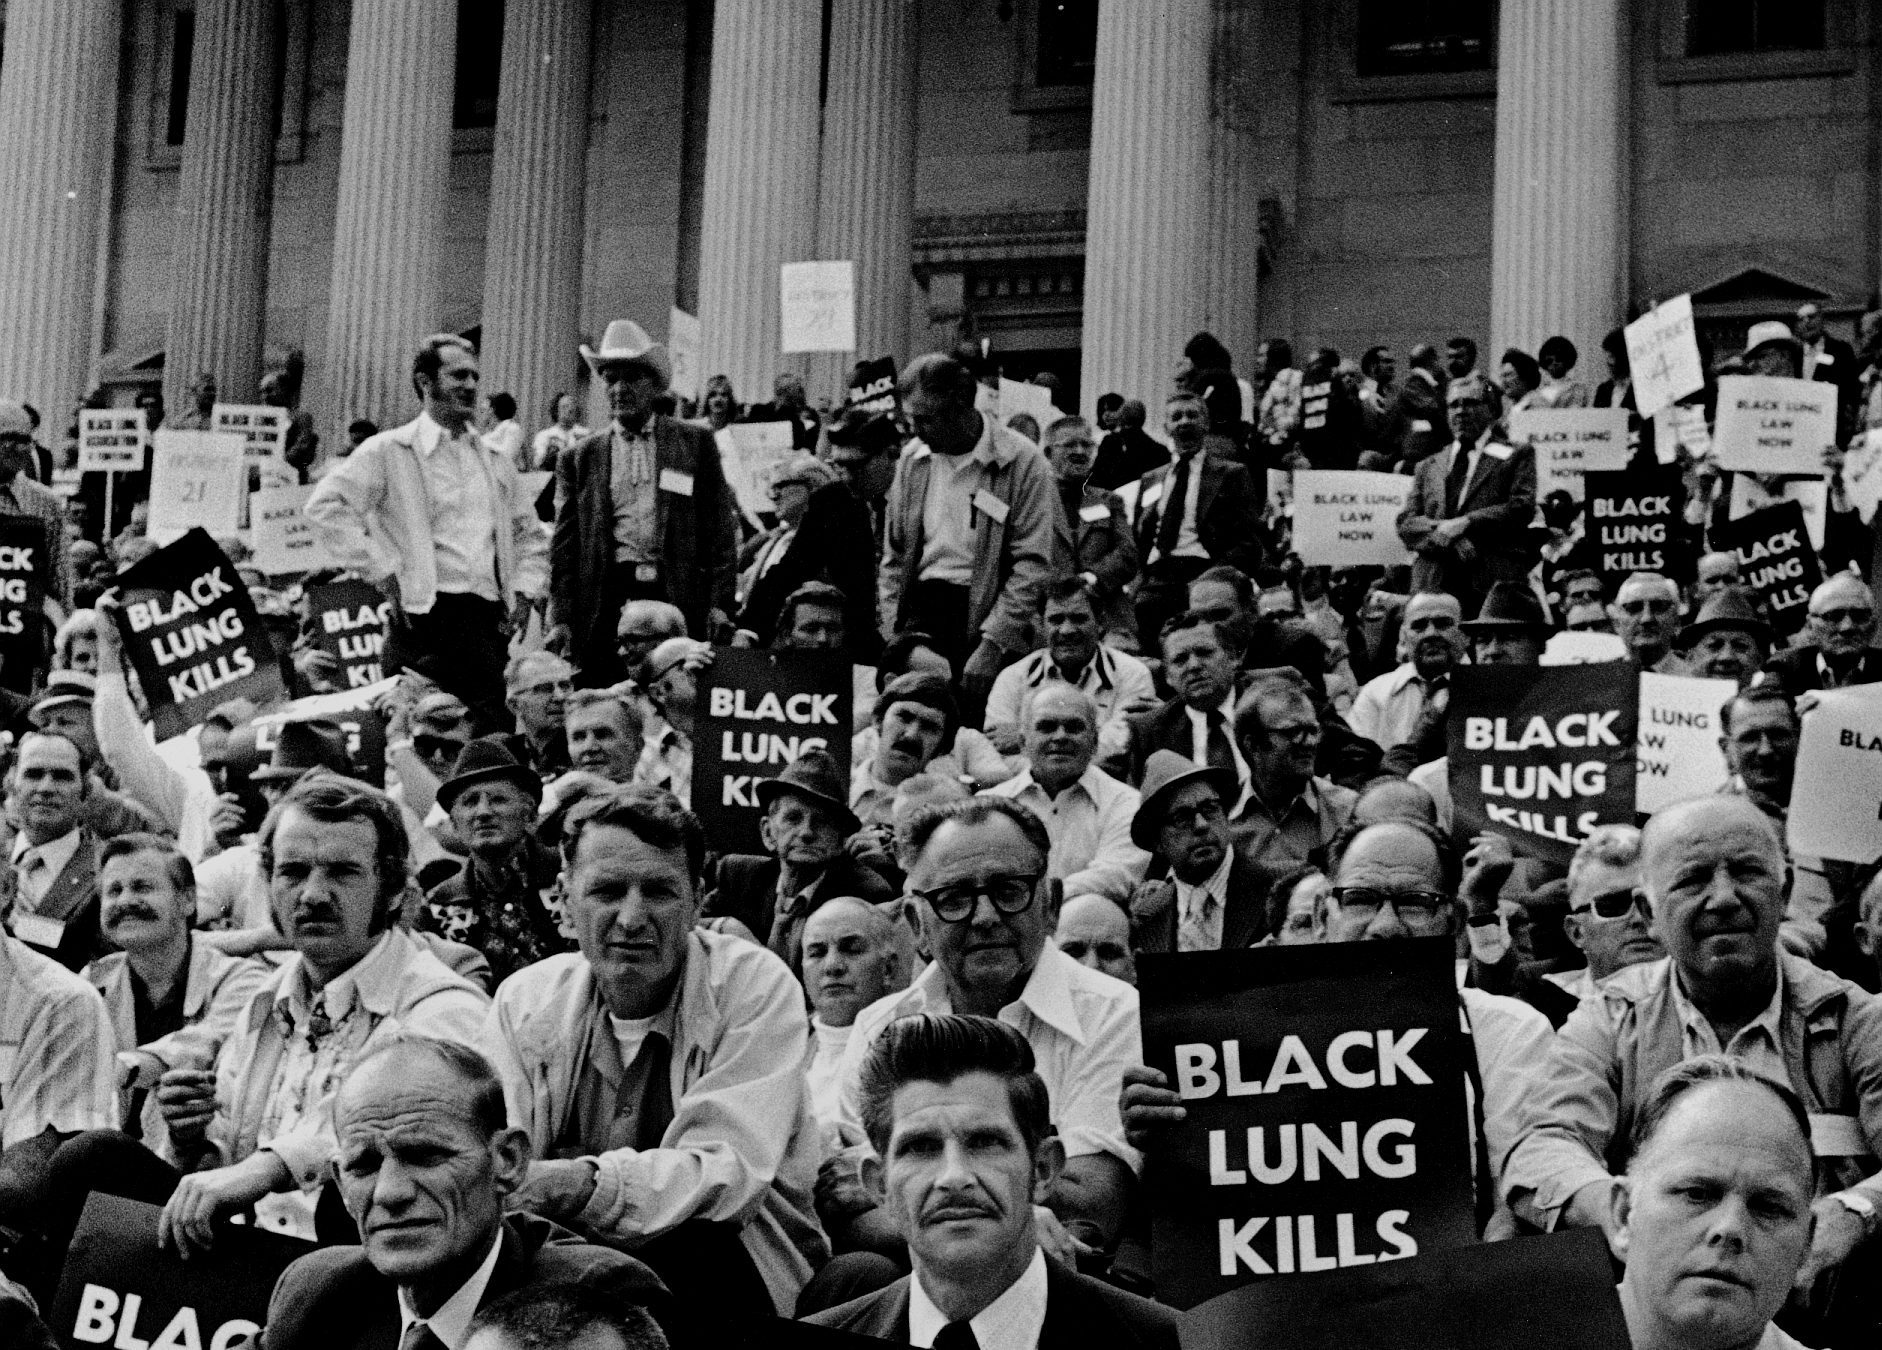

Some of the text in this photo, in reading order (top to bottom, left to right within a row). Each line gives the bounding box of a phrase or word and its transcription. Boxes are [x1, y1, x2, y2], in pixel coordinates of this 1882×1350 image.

[181, 481, 208, 503] 21
[1314, 494, 1358, 505] BLACK
[1593, 495, 1671, 518] BLACK
[1340, 512, 1374, 523] LAW
[1338, 530, 1374, 541] NOW
[1601, 523, 1667, 545] LUNG
[1736, 528, 1801, 565] LACK
[1603, 550, 1665, 571] KILLS
[1740, 557, 1804, 588] UNG
[126, 566, 233, 633] BLACK
[1770, 584, 1809, 611] LLS
[322, 601, 393, 634] BLAC
[151, 607, 244, 666] LUNG
[168, 646, 256, 704] KILLS
[710, 686, 839, 725] BLACK
[1652, 707, 1709, 729] LUNG
[1464, 710, 1621, 751] BLACK
[1840, 728, 1882, 752] BLA
[1480, 762, 1607, 800] LUNG
[1636, 759, 1669, 777] OW
[1485, 803, 1599, 845] KILLS
[1174, 1027, 1434, 1100] BLACK
[1208, 1117, 1417, 1186] LUNG
[1217, 1209, 1419, 1276] KILLS
